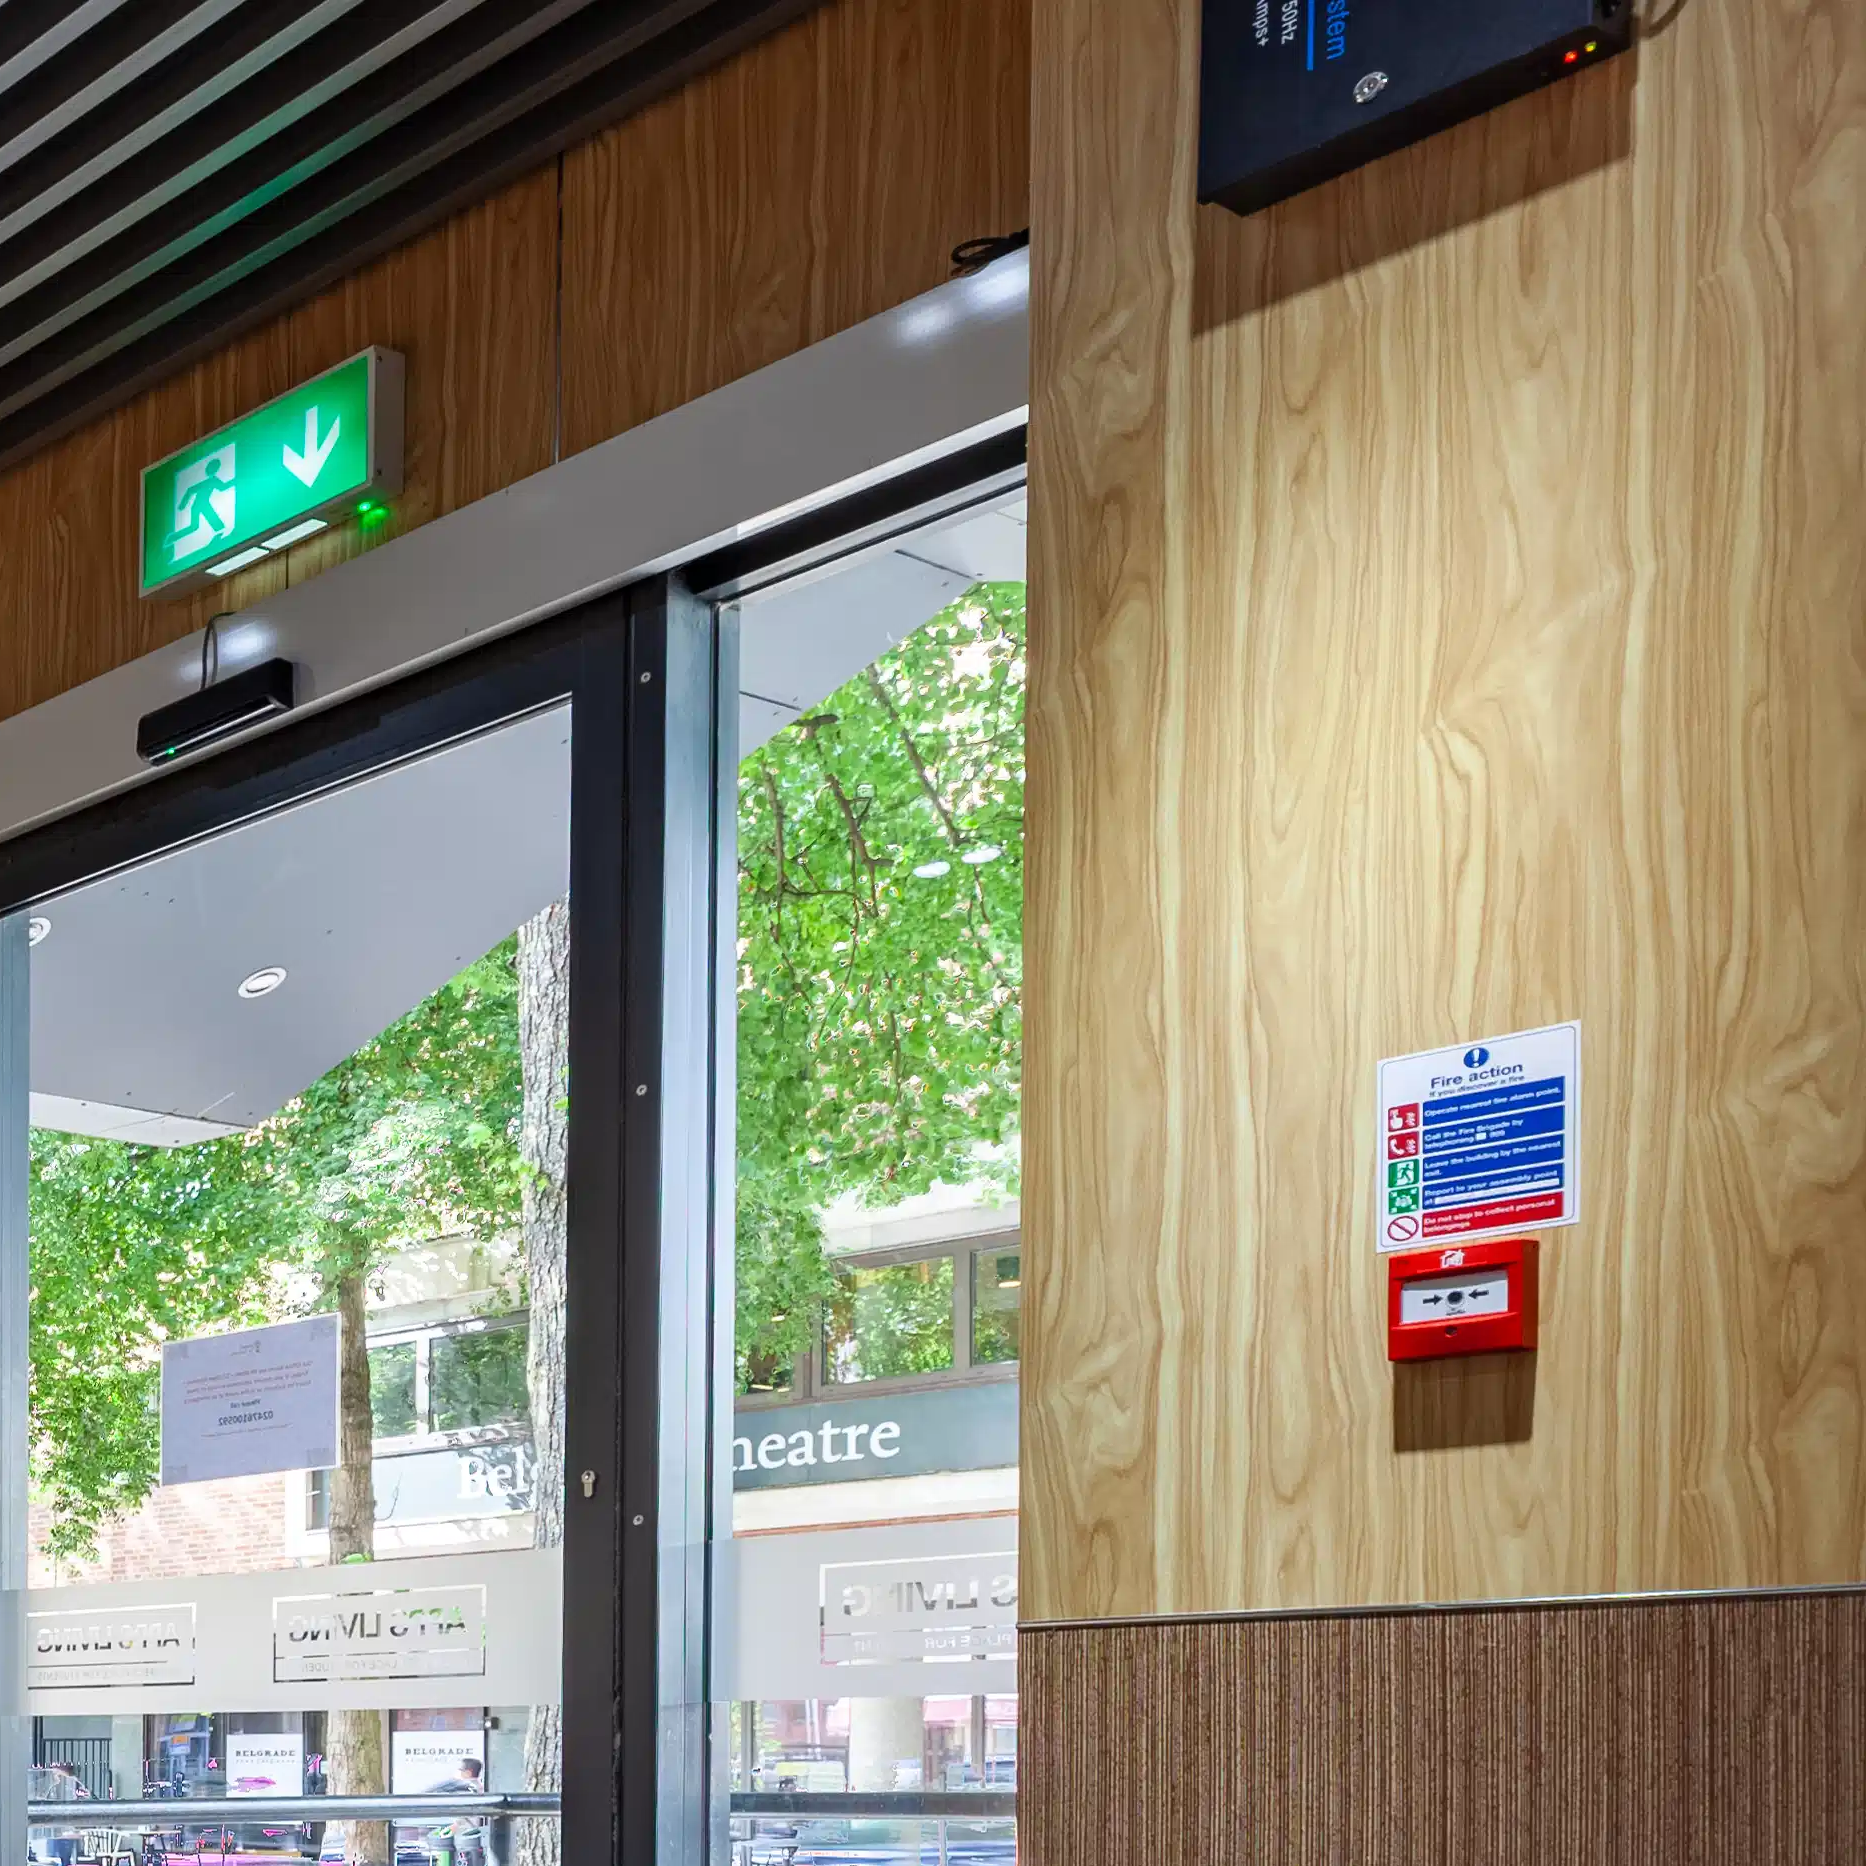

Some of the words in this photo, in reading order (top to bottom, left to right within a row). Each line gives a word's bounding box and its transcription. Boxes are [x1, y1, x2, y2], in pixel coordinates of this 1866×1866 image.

[1431, 1075, 1463, 1089] Fire
[1469, 1063, 1523, 1082] action
[457, 1444, 539, 1511] Bel
[235, 1749, 296, 1758] BELGRADE
[405, 1747, 474, 1756] BELGRADE
